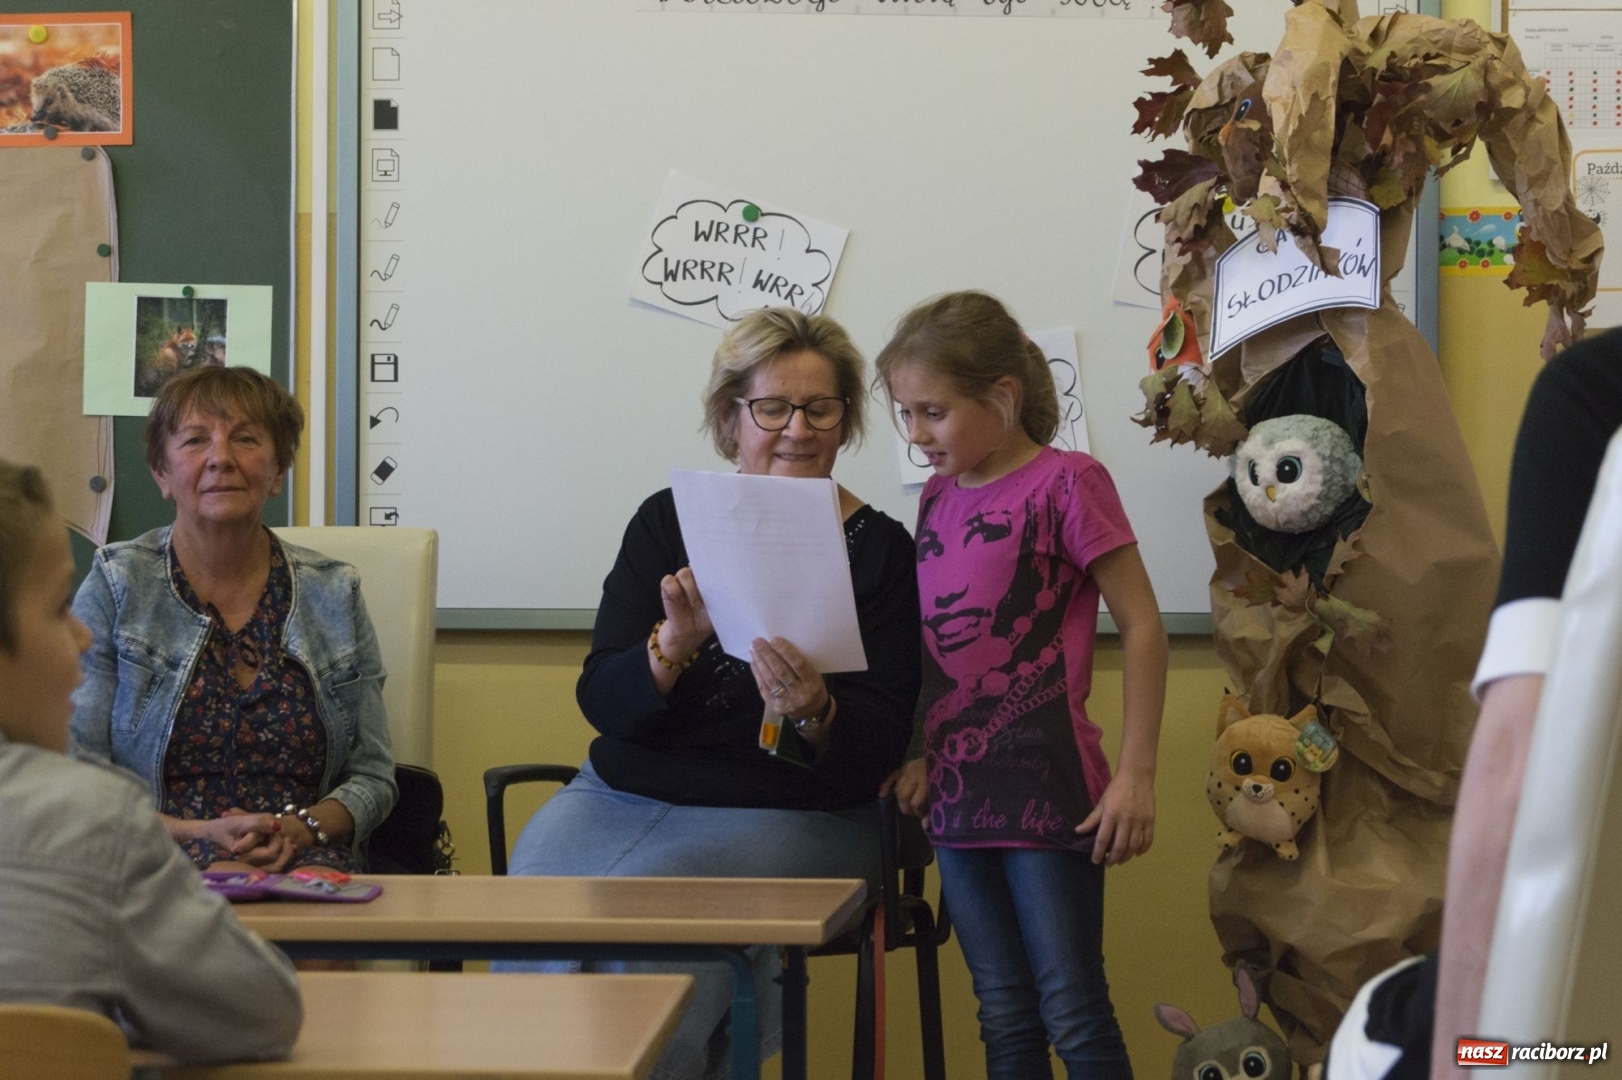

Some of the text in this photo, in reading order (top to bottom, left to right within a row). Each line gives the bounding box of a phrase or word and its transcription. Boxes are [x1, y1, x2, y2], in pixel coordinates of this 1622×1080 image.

[1587, 161, 1622, 175] Paźd
[1227, 237, 1377, 319] SŁODZIÓW
[971, 797, 1008, 829] the
[1021, 798, 1064, 836] life
